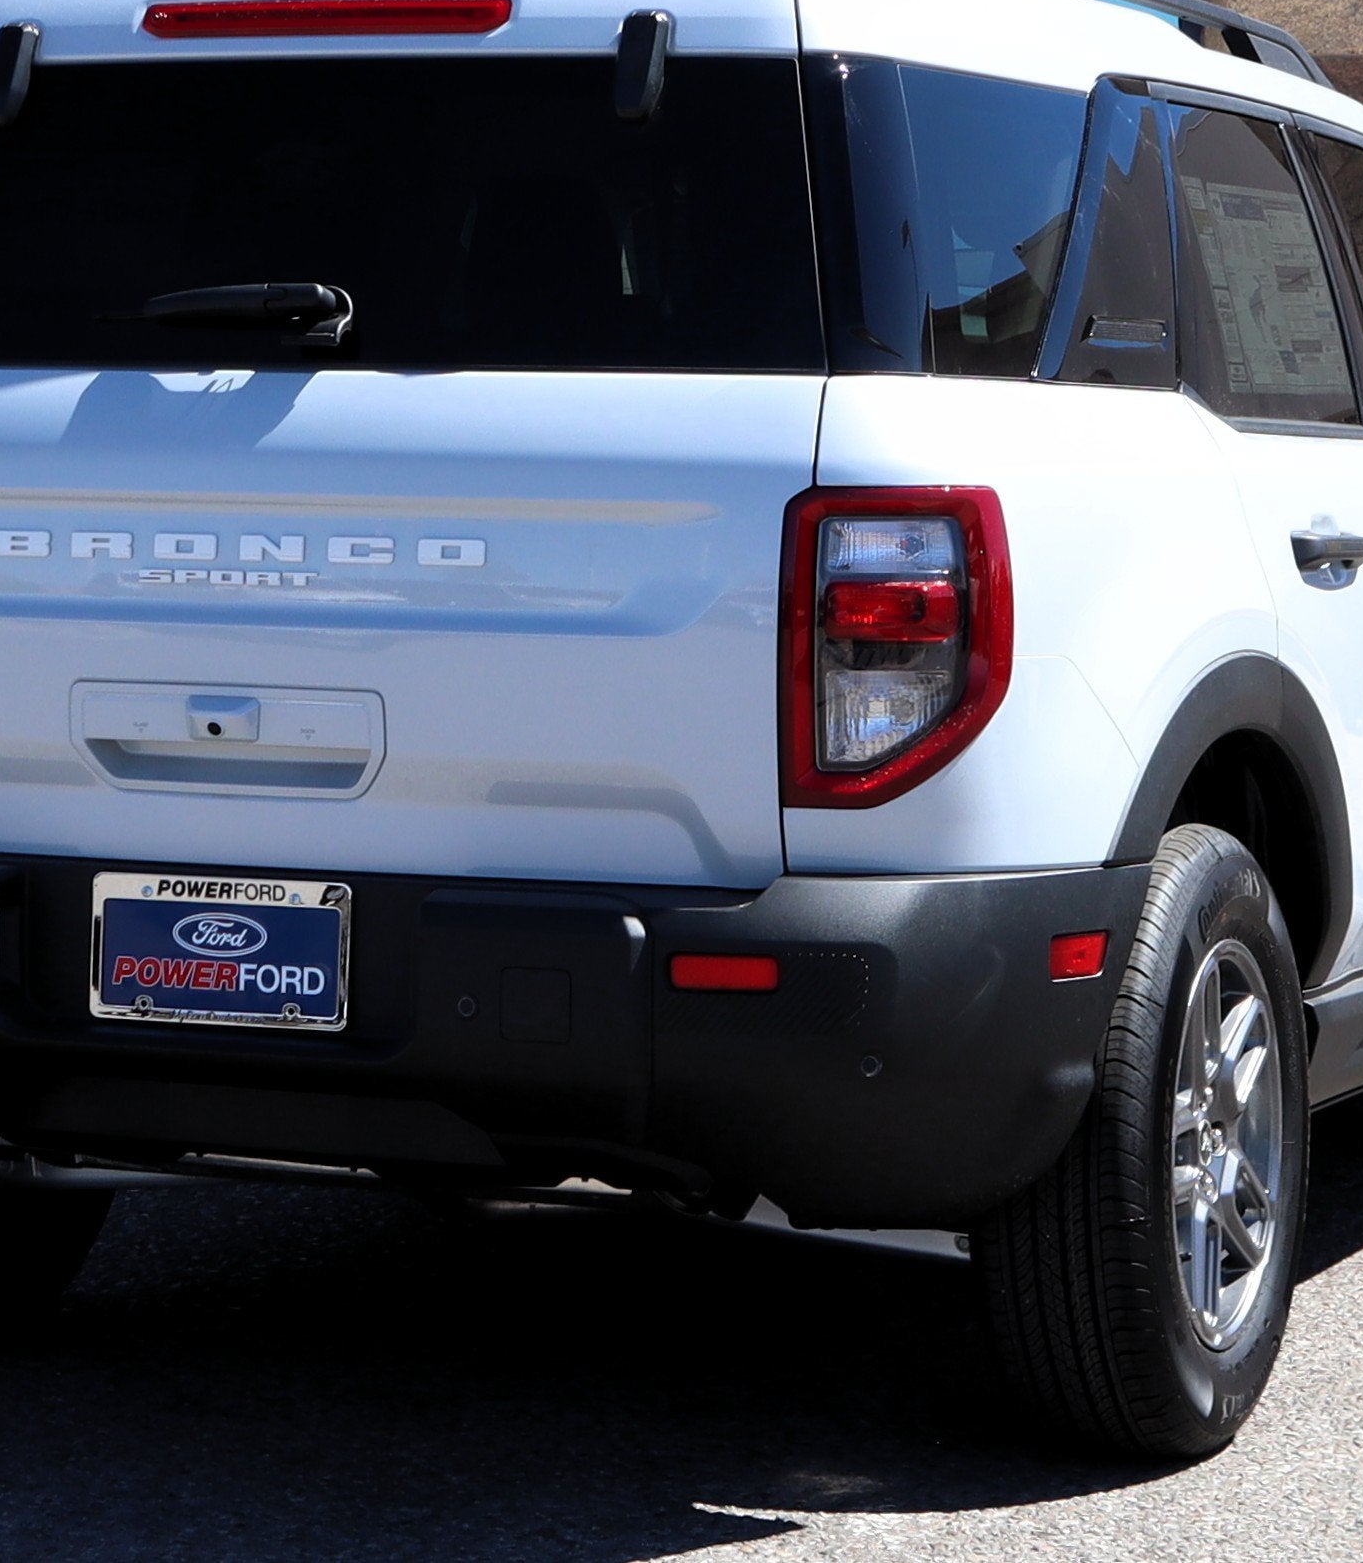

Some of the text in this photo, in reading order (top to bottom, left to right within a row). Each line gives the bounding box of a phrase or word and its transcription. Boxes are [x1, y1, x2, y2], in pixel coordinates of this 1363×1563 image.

[138, 569, 319, 587] SPORT
[156, 879, 286, 902] POWERFORD
[191, 919, 248, 948] Ford
[111, 956, 325, 995] POWERFORD
